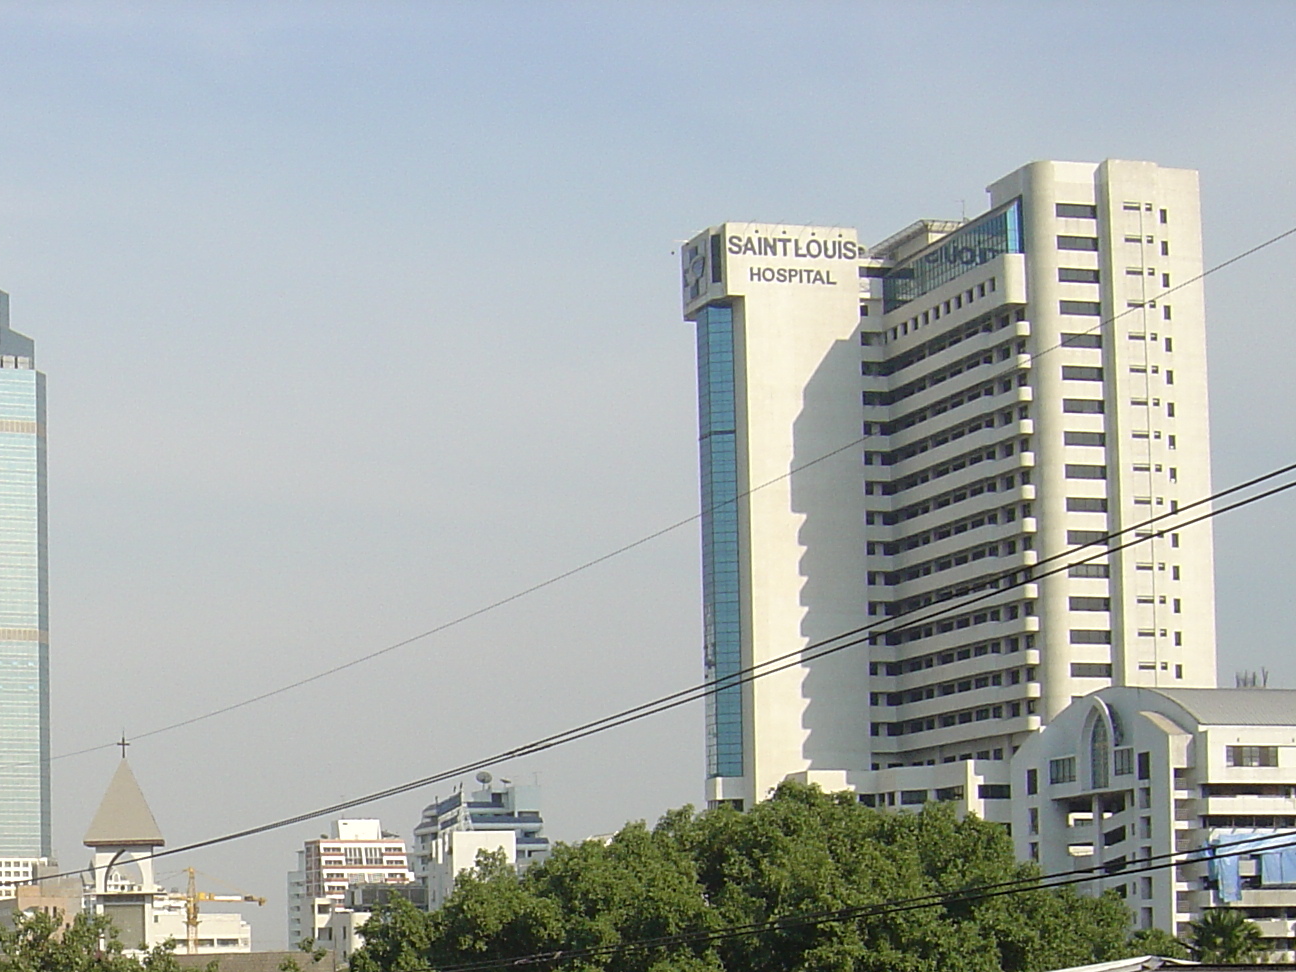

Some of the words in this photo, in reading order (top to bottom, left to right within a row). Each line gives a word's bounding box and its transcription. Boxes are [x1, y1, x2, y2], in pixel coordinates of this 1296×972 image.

[728, 236, 791, 257] SAINT
[795, 239, 857, 260] LOUIS
[749, 267, 837, 285] HOSPITAL
